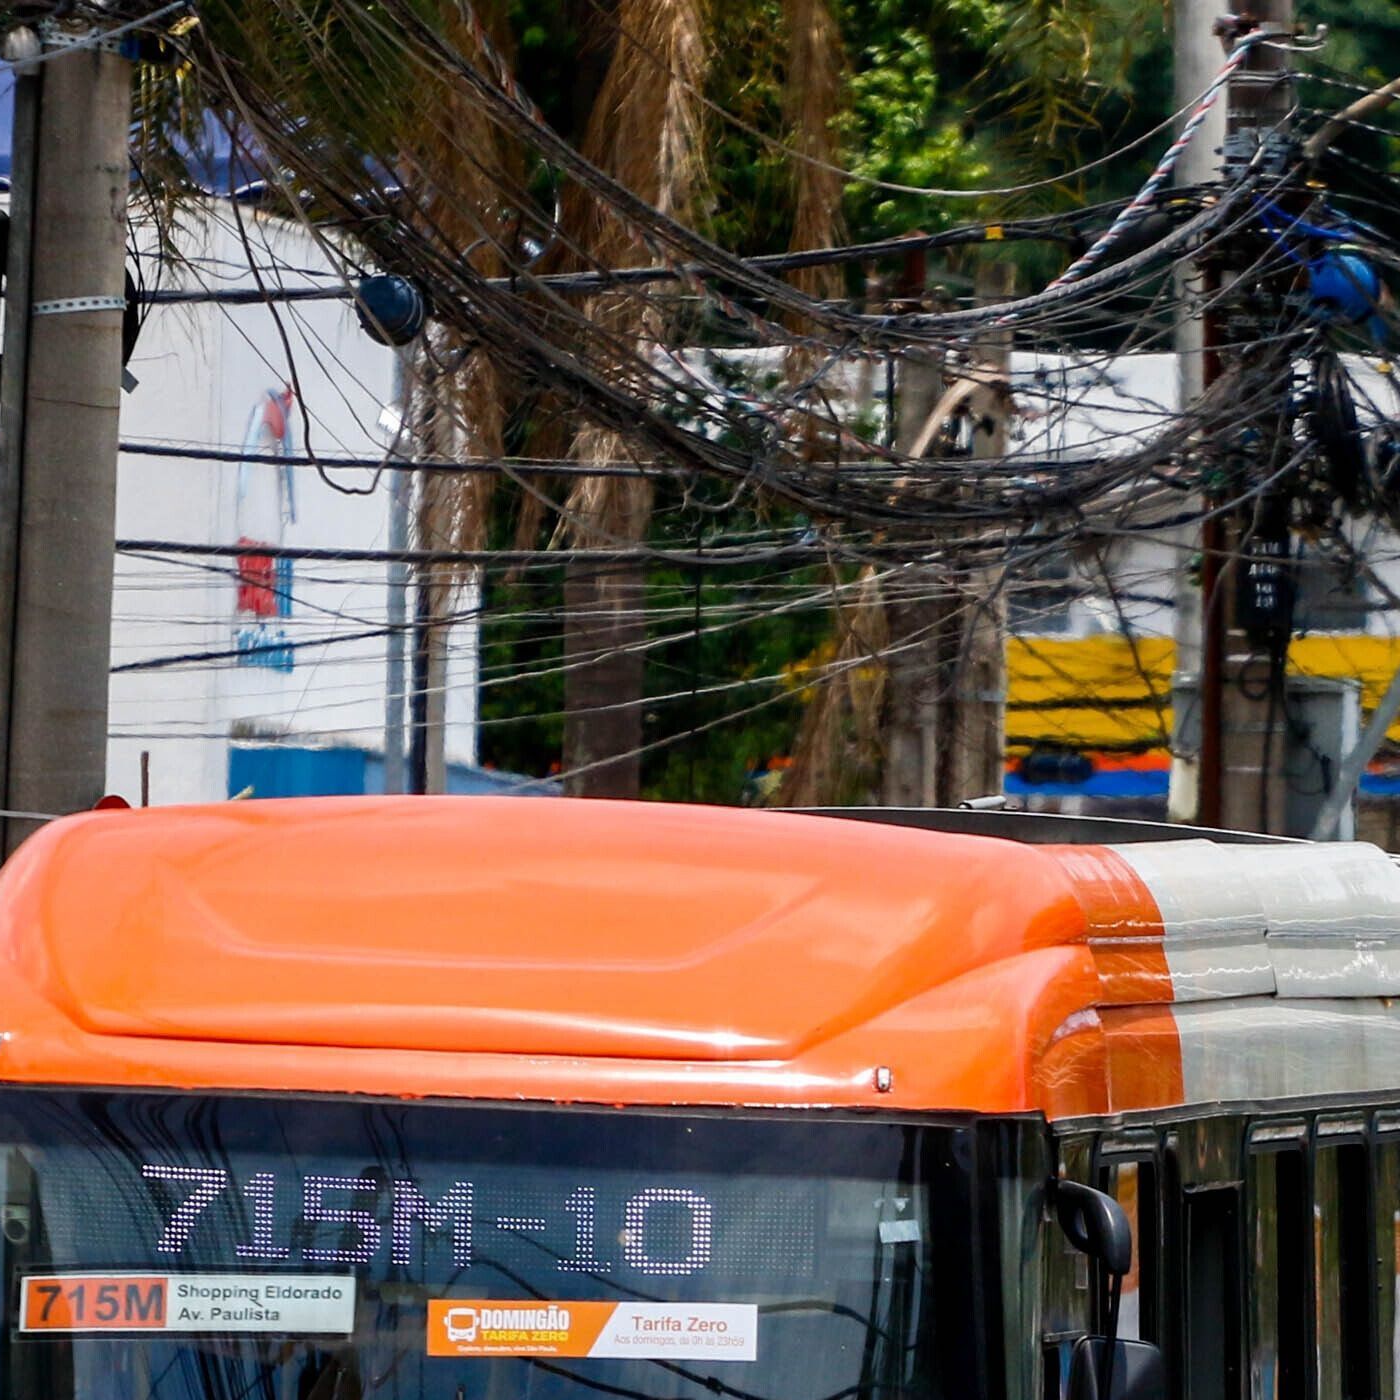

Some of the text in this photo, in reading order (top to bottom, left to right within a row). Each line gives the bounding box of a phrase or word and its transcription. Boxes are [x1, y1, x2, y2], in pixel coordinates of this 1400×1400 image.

[142, 1164, 713, 1276] 715M-10
[177, 1284, 343, 1302] Shopping Eldorado
[35, 1284, 163, 1321] 715M
[178, 1307, 281, 1321] Av. Paulista
[480, 1305, 570, 1330] DOMINGÃO
[632, 1316, 728, 1332] Tarifa Zero
[481, 1330, 569, 1342] TARIFA ZERO
